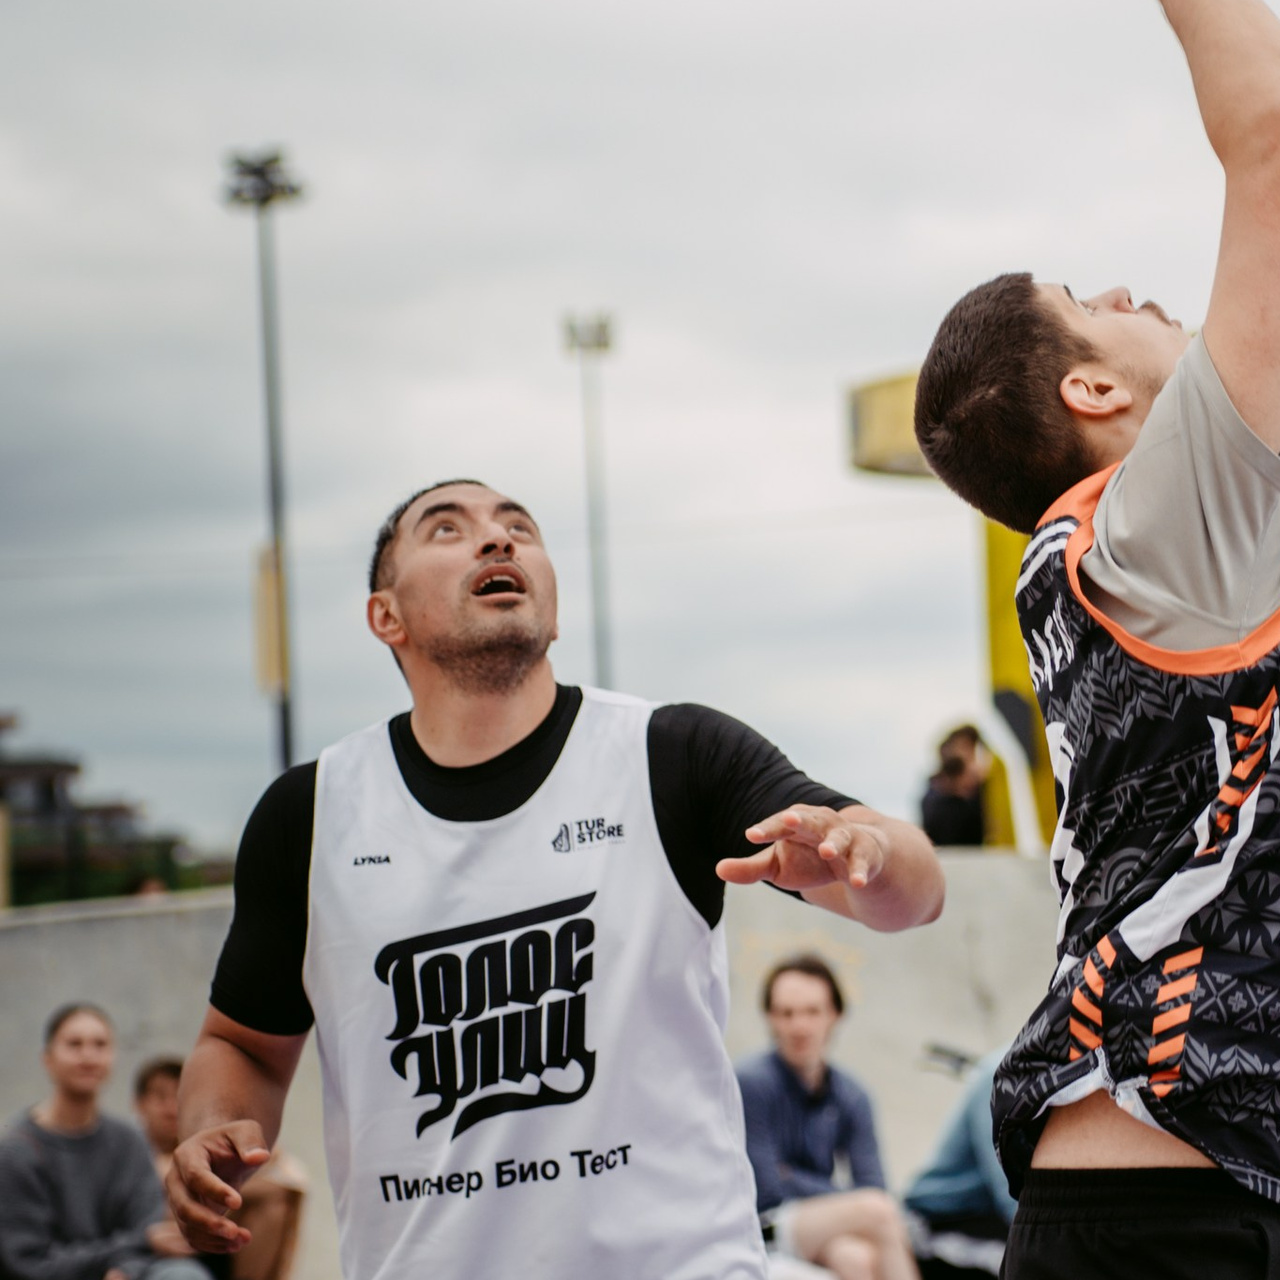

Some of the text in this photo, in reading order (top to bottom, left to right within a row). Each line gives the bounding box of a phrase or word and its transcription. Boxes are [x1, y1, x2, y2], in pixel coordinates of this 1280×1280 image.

[575, 817, 605, 832] TUR
[577, 824, 625, 844] STORE
[494, 1158, 561, 1189] Био
[569, 1143, 632, 1178] Тест
